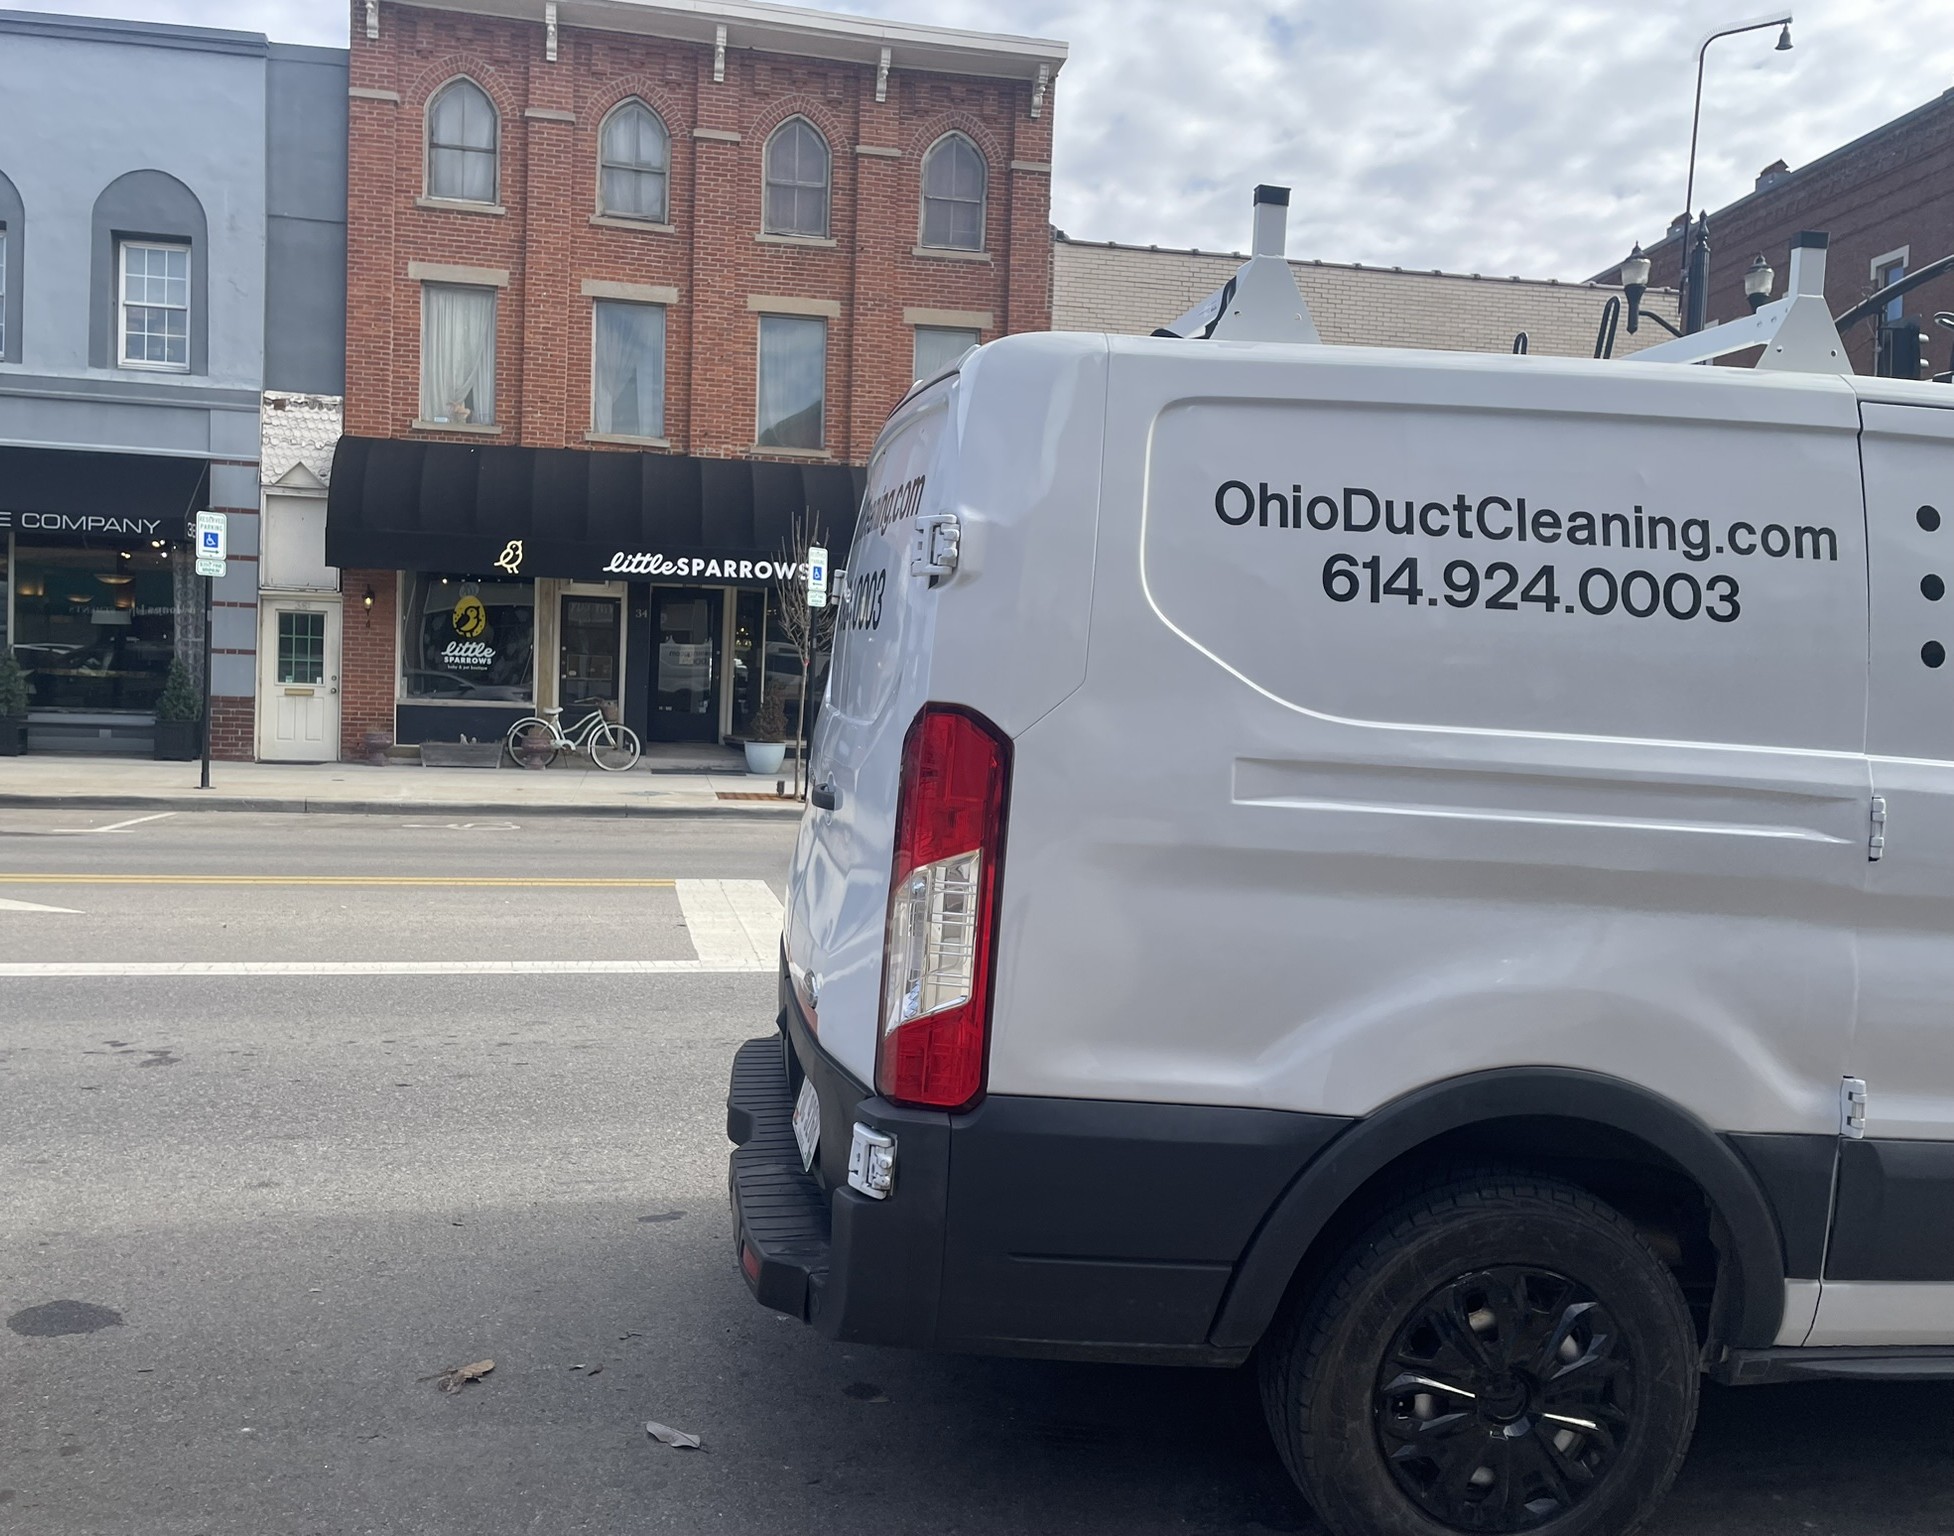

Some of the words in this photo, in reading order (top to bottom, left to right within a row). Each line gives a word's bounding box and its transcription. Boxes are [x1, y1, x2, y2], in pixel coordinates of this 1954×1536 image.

[21, 512, 161, 534] COMPANY
[200, 523, 223, 532] PARKING
[1214, 479, 1838, 562] OhioDuctCleaning.com
[1322, 552, 1741, 623] 614.924.0003
[635, 608, 648, 619] 34
[440, 641, 496, 658] little
[443, 656, 492, 665] SPARROWS
